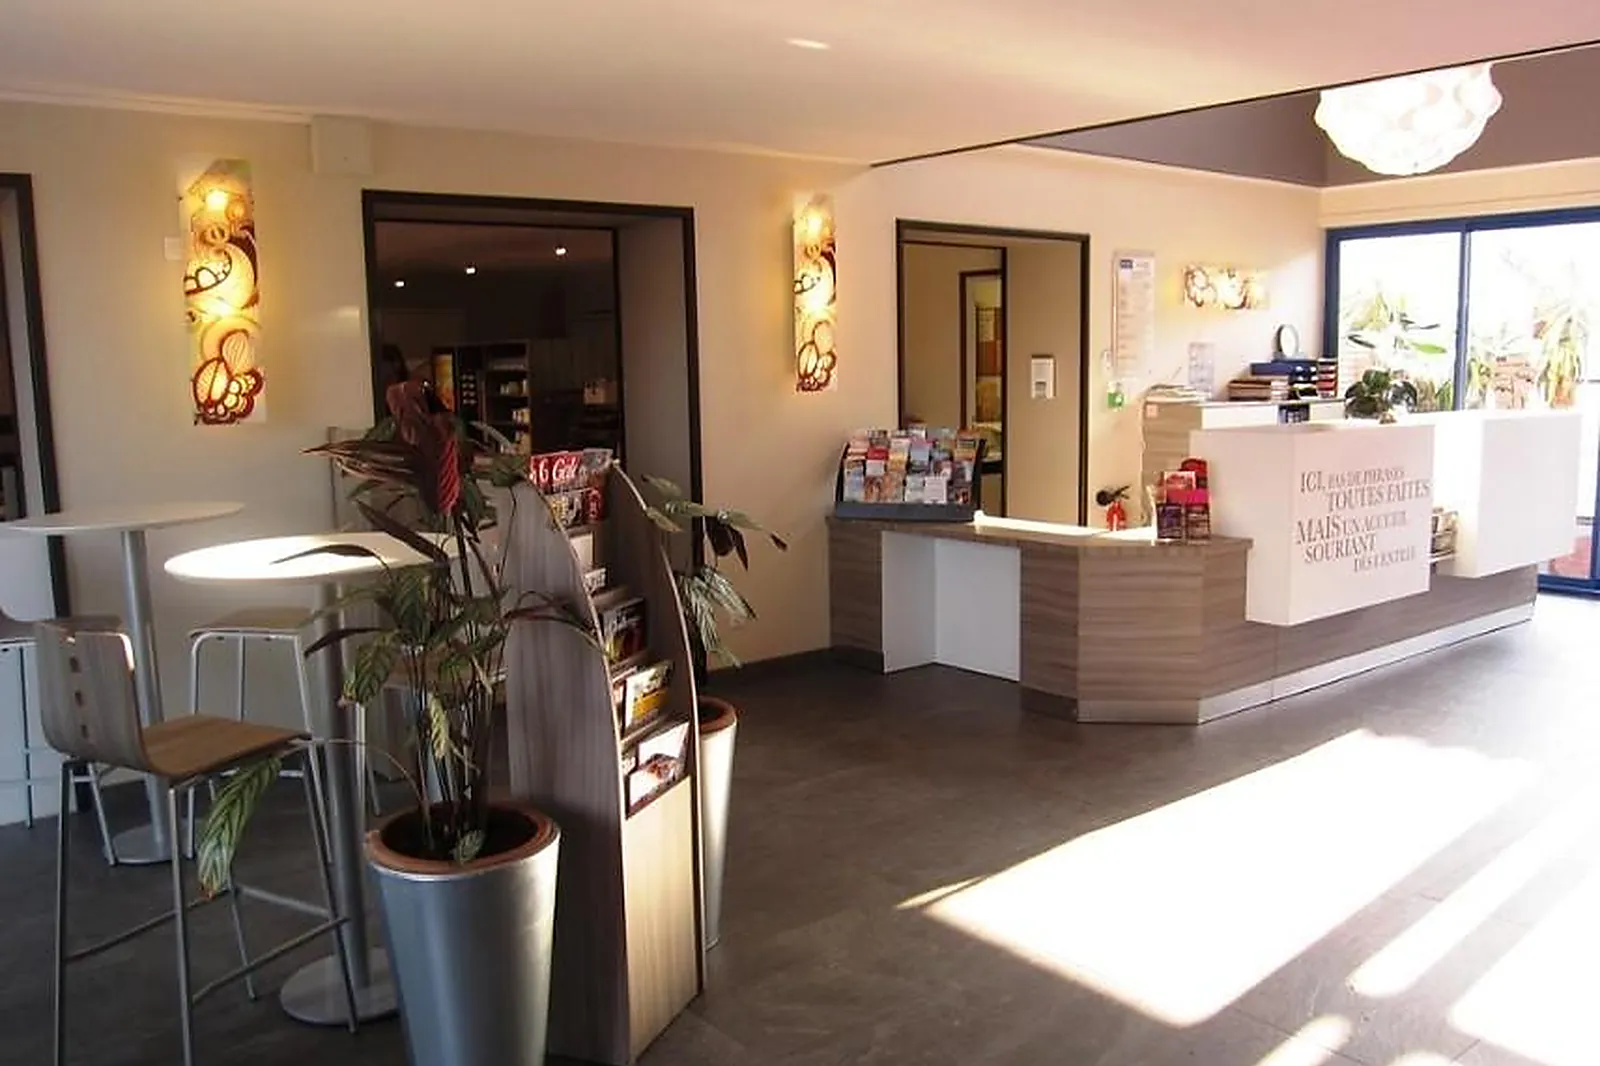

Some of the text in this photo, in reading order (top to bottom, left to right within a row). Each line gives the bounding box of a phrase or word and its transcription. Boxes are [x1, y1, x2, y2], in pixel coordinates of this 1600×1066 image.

[1327, 479, 1431, 512] TOUTES FAITES
[1297, 515, 1340, 544] MAIS
[1304, 534, 1376, 563] SOURIANT
